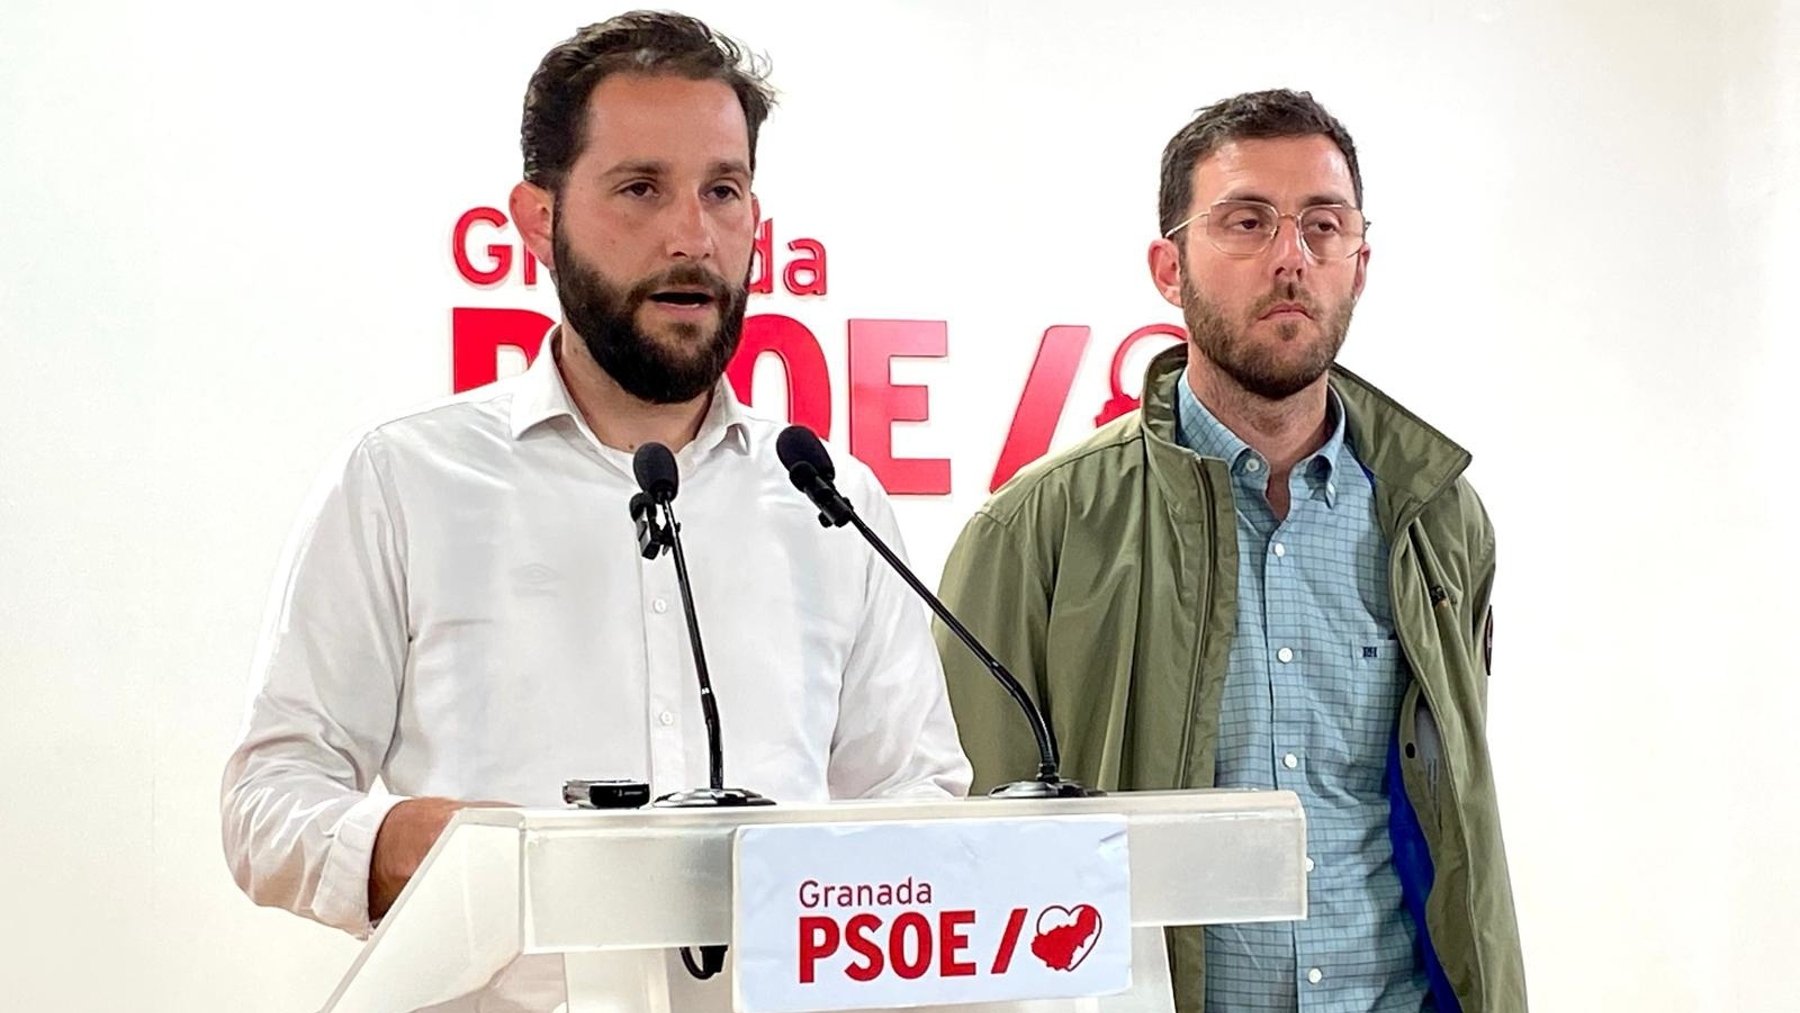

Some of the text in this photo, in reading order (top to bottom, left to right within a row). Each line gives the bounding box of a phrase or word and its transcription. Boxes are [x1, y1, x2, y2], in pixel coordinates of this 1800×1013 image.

[453, 307, 952, 496] POE
[799, 877, 932, 909] Granada
[799, 910, 977, 984] PSOE
